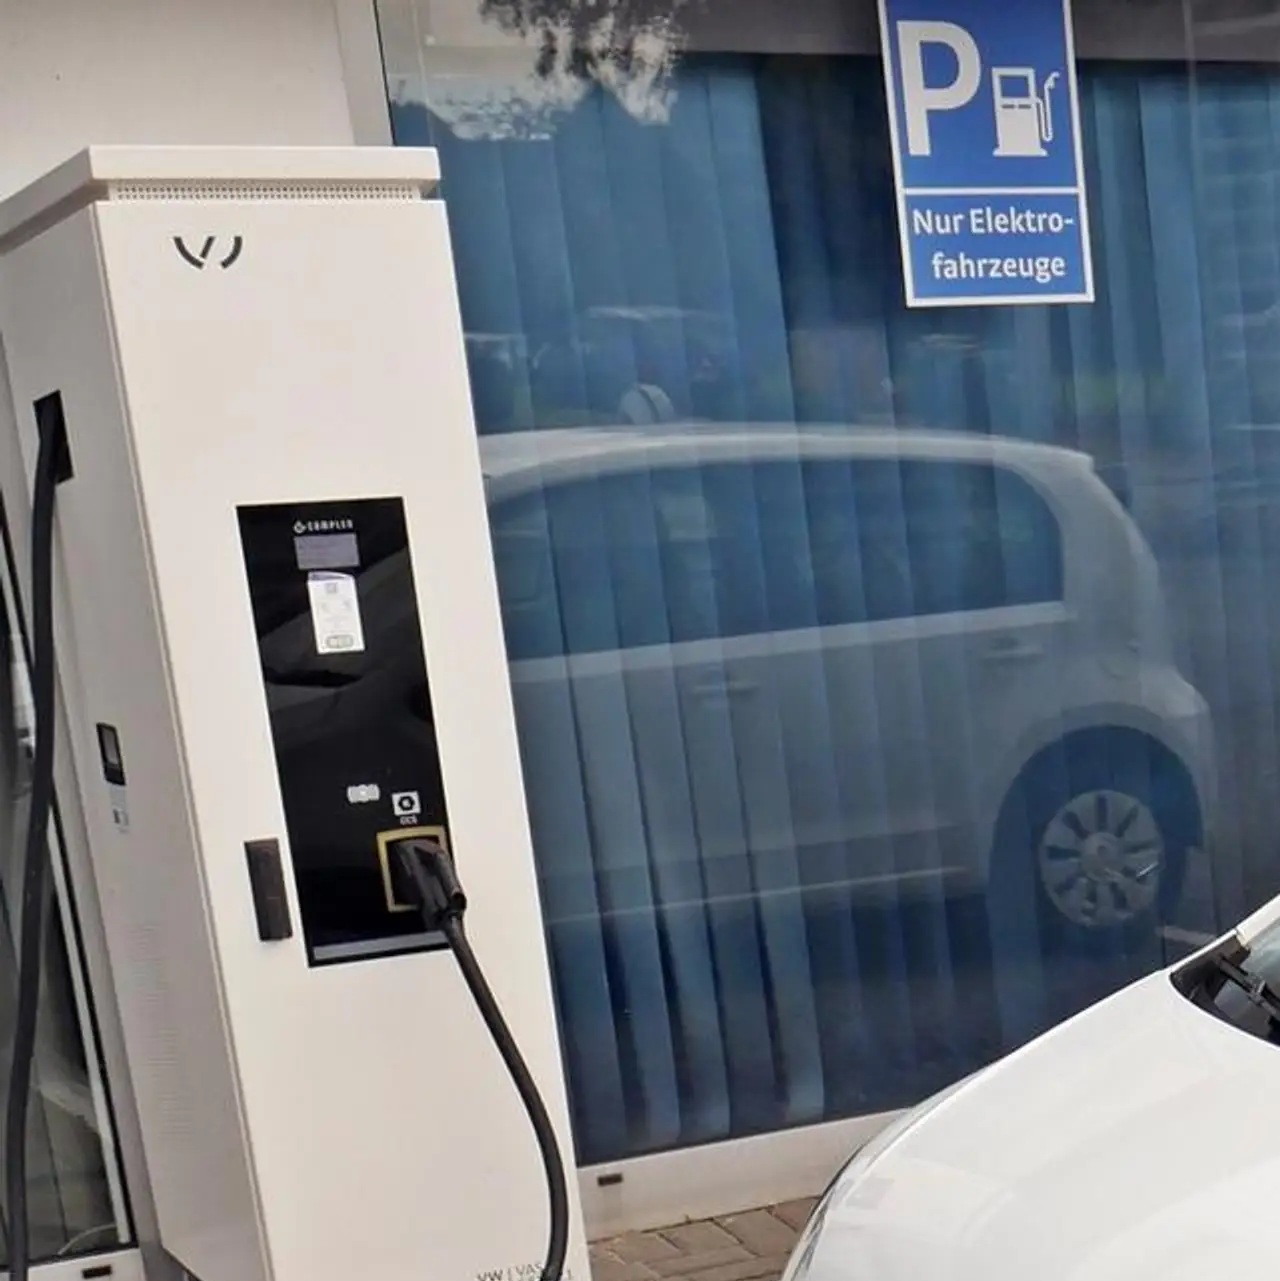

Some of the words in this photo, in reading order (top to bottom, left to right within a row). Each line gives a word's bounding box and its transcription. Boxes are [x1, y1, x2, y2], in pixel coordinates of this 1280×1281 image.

[897, 20, 981, 157] P
[912, 207, 965, 235] Nur
[969, 205, 1076, 235] Elektro-
[931, 251, 1067, 284] fahrzeuge
